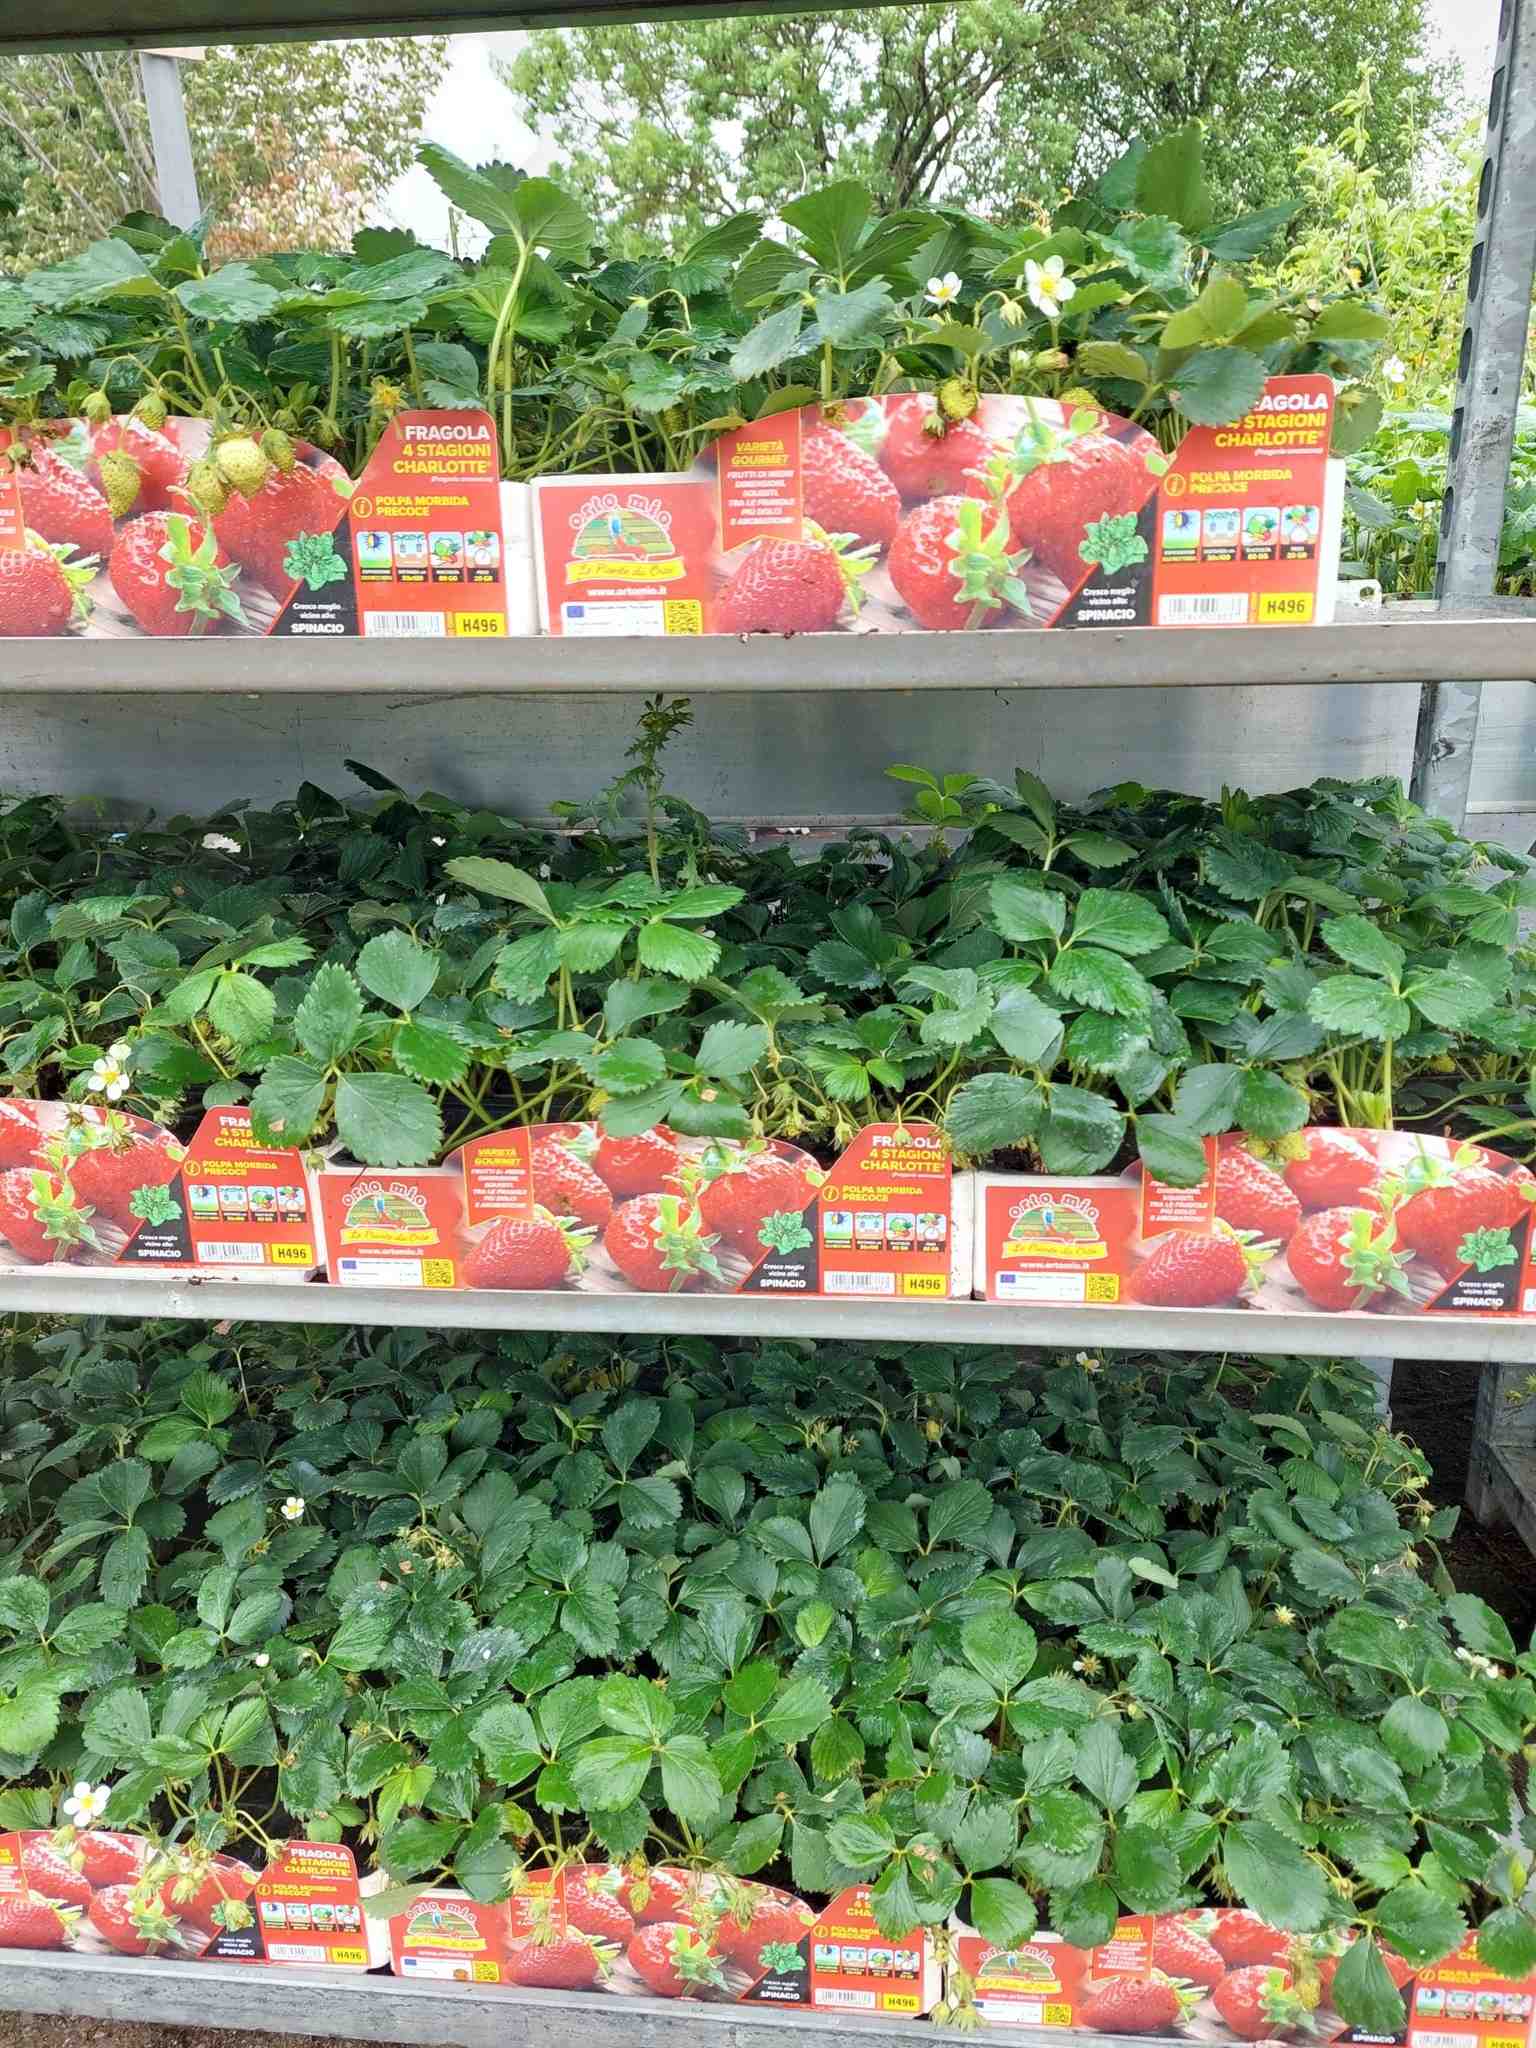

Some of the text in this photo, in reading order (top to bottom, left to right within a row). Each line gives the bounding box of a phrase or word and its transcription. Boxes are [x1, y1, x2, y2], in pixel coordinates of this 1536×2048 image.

[1254, 393, 1329, 411] AGOLA
[1243, 413, 1326, 429] STAGIONI
[405, 425, 490, 441] FRAGOLA
[402, 443, 491, 457] 4 STAGIONI
[731, 454, 789, 466] GOURMET
[1190, 469, 1292, 483] POLPA MORBIDA
[1190, 482, 1249, 494] PRECOCE
[376, 496, 470, 507] POLPA MORBIDA
[376, 506, 431, 517] PRECOCE
[1267, 599, 1306, 615] H496
[1077, 608, 1136, 622] SPINACIO
[290, 623, 345, 635] SPINACIO
[463, 618, 499, 633] H496
[869, 1148, 878, 1159] 4
[342, 1181, 427, 1209] orto mio
[843, 1185, 875, 1194] POLPA
[137, 1249, 182, 1258] SPINACIO
[278, 1247, 307, 1259] H496
[760, 1279, 807, 1289] SPINACIO
[910, 1279, 941, 1290] H496
[1452, 1296, 1505, 1308] SPINACIO
[760, 1990, 801, 2000] SPINACIO
